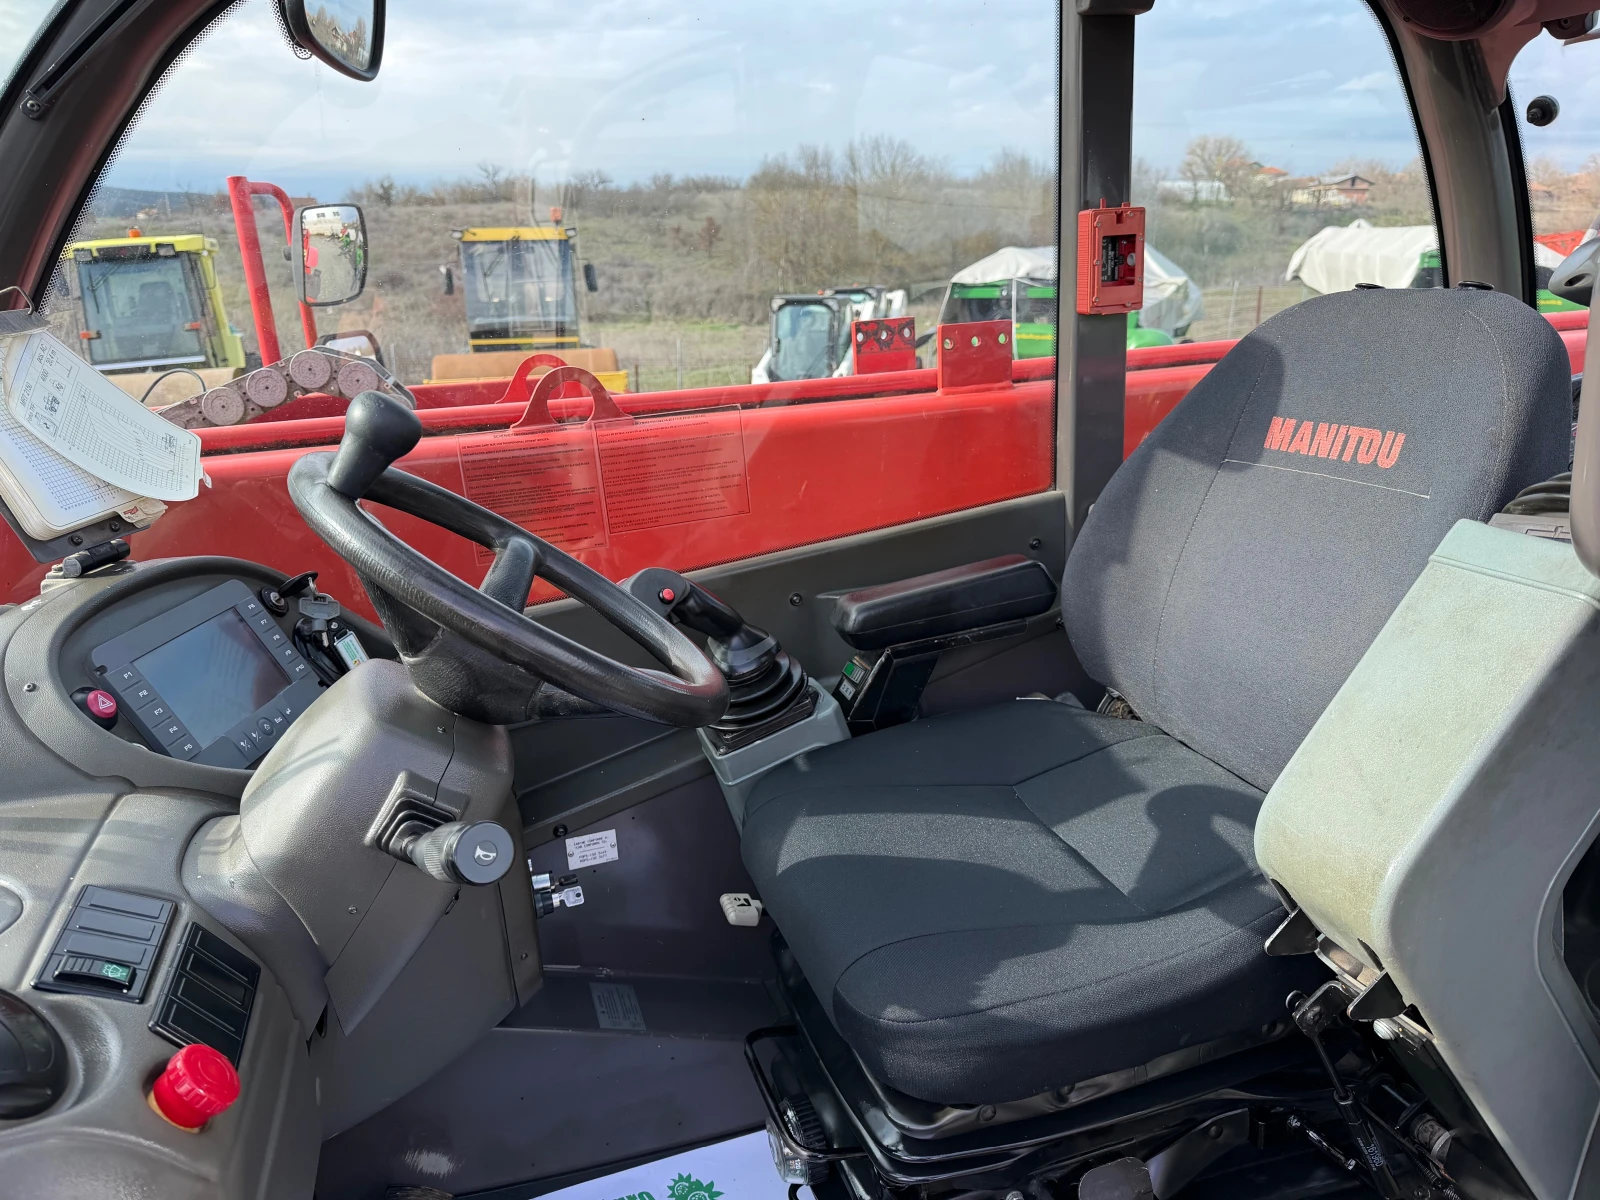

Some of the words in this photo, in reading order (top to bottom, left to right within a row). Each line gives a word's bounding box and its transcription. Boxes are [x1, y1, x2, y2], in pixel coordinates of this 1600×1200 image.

[20, 395, 28, 407] MRT
[24, 382, 33, 396] 2150
[1264, 416, 1406, 469] MANITOU
[296, 664, 304, 672] F10
[124, 671, 132, 679] F1
[138, 690, 148, 698] F2
[154, 708, 163, 716] F3
